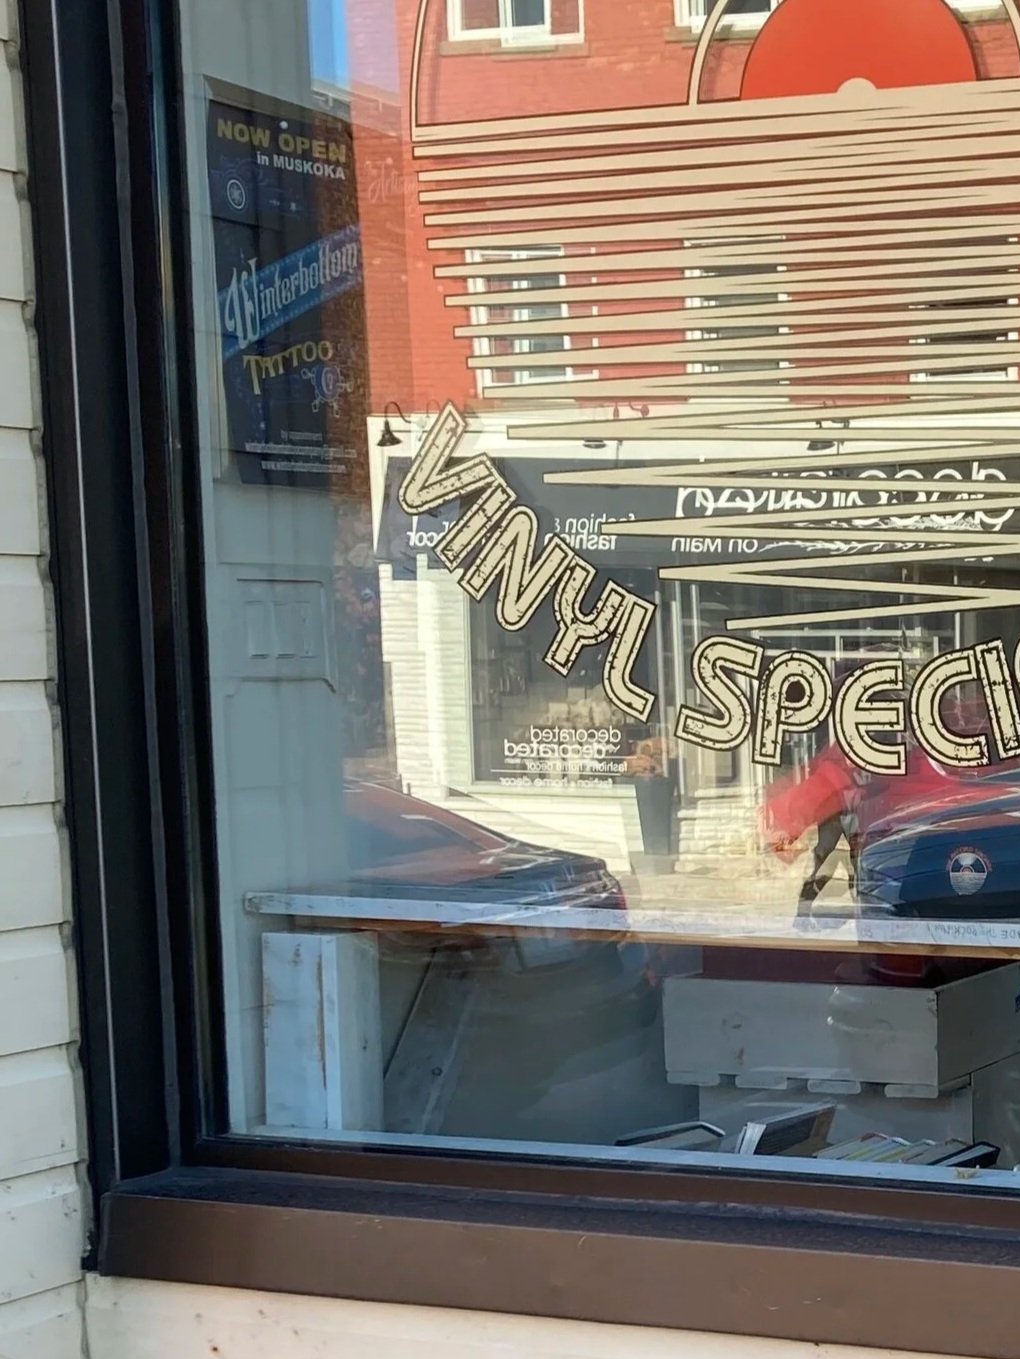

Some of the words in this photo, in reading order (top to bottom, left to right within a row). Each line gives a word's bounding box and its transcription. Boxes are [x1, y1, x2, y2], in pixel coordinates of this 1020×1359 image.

[216, 118, 271, 148] NOW
[278, 133, 346, 163] OPEN
[256, 151, 269, 166] in
[273, 154, 346, 180] MUSKOKA
[242, 340, 333, 395] TATTOO
[399, 399, 657, 723] VINYL
